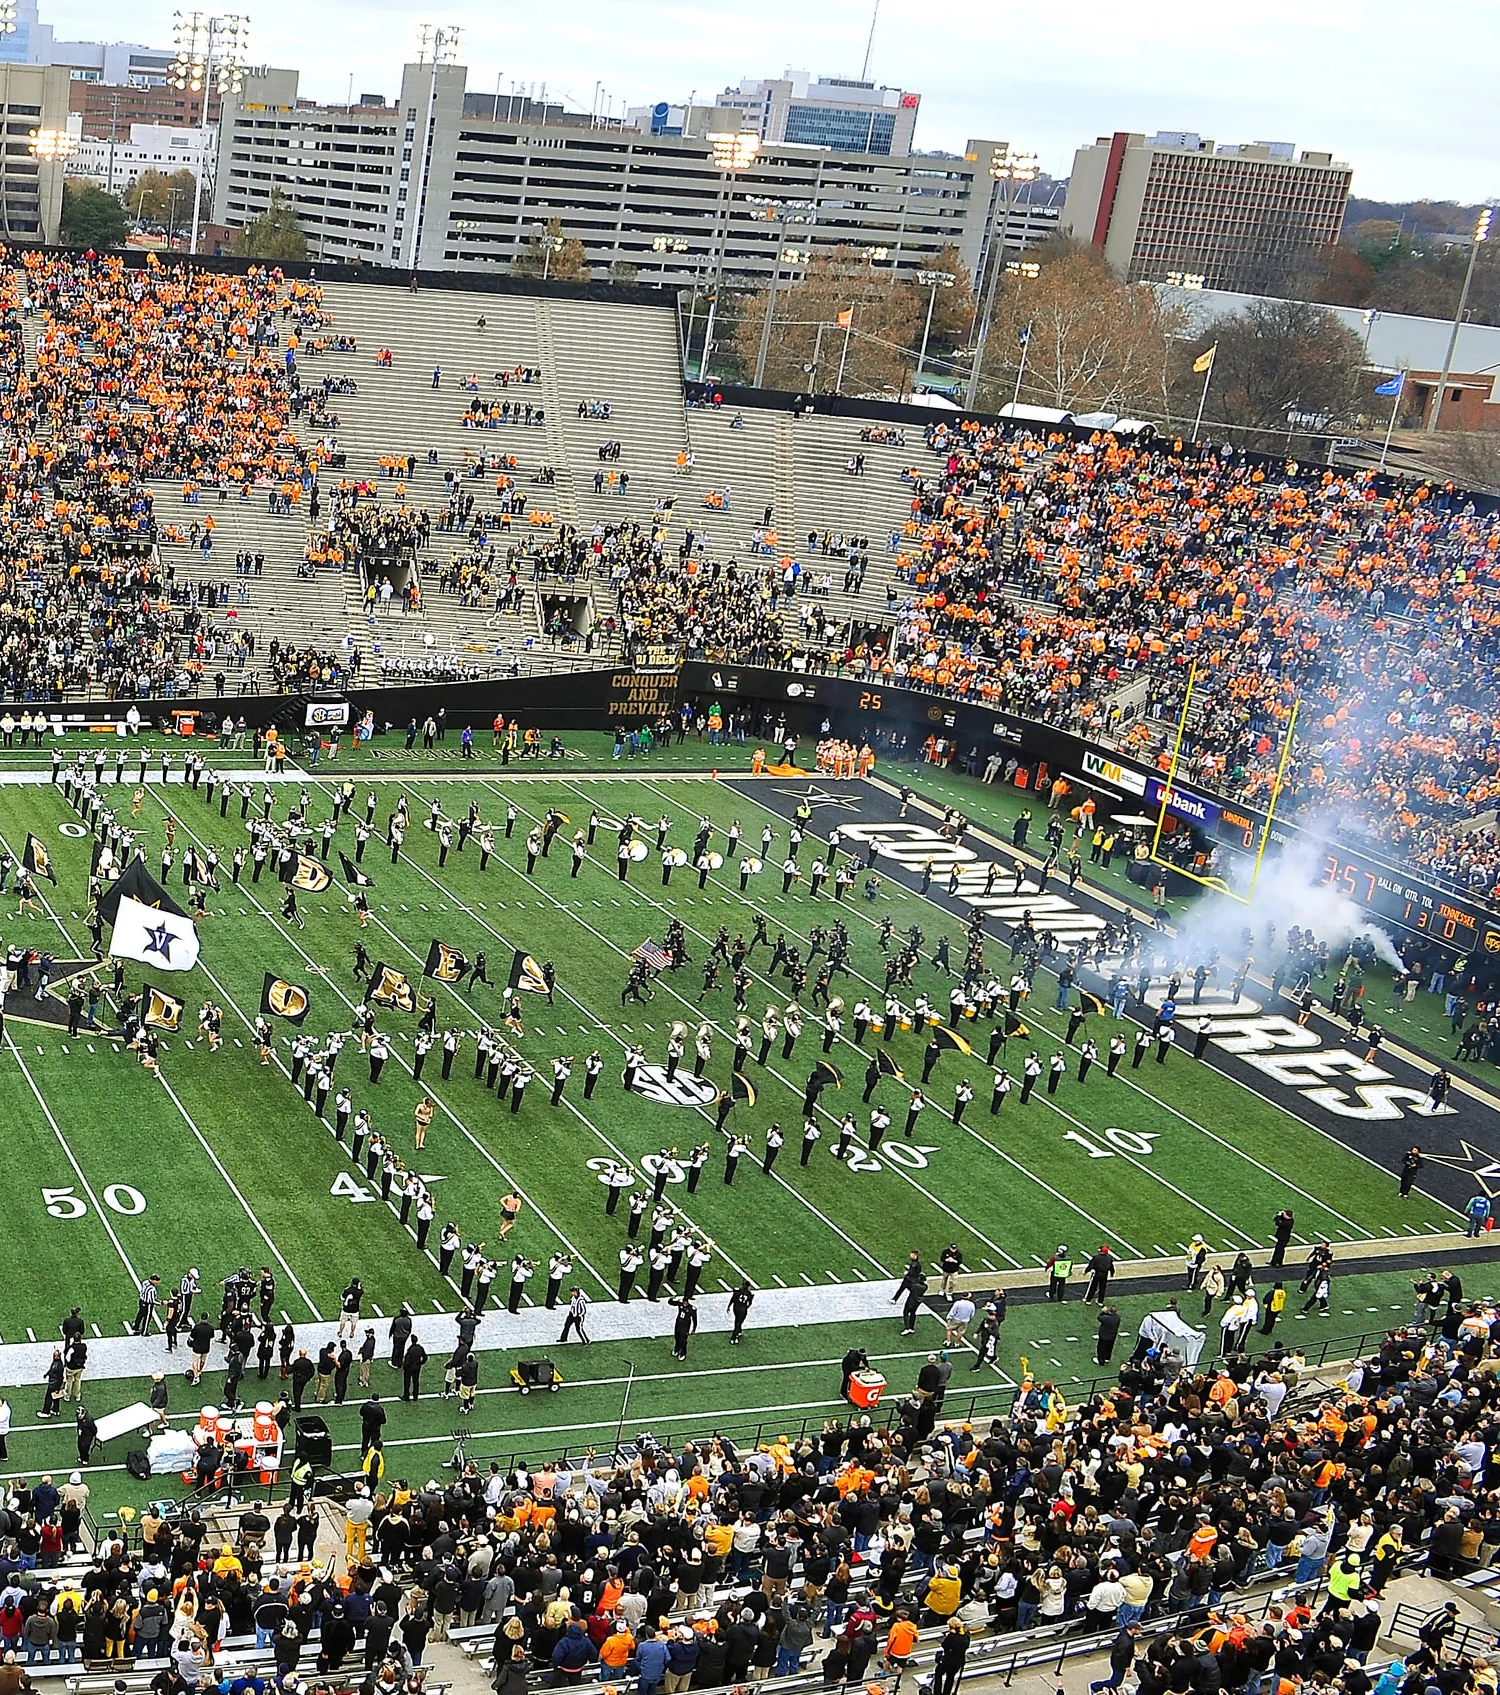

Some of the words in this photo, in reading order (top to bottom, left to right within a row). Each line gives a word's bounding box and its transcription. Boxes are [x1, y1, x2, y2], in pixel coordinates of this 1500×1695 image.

[612, 675, 678, 687] CONQUER
[628, 688, 658, 700] AND
[859, 692, 882, 710] 25
[609, 703, 671, 714] PREVAIL
[1439, 903, 1476, 928] TENNESSEE
[40, 1183, 147, 1219] 50
[867, 1389, 880, 1402] G
[583, 1590, 593, 1603] 8
